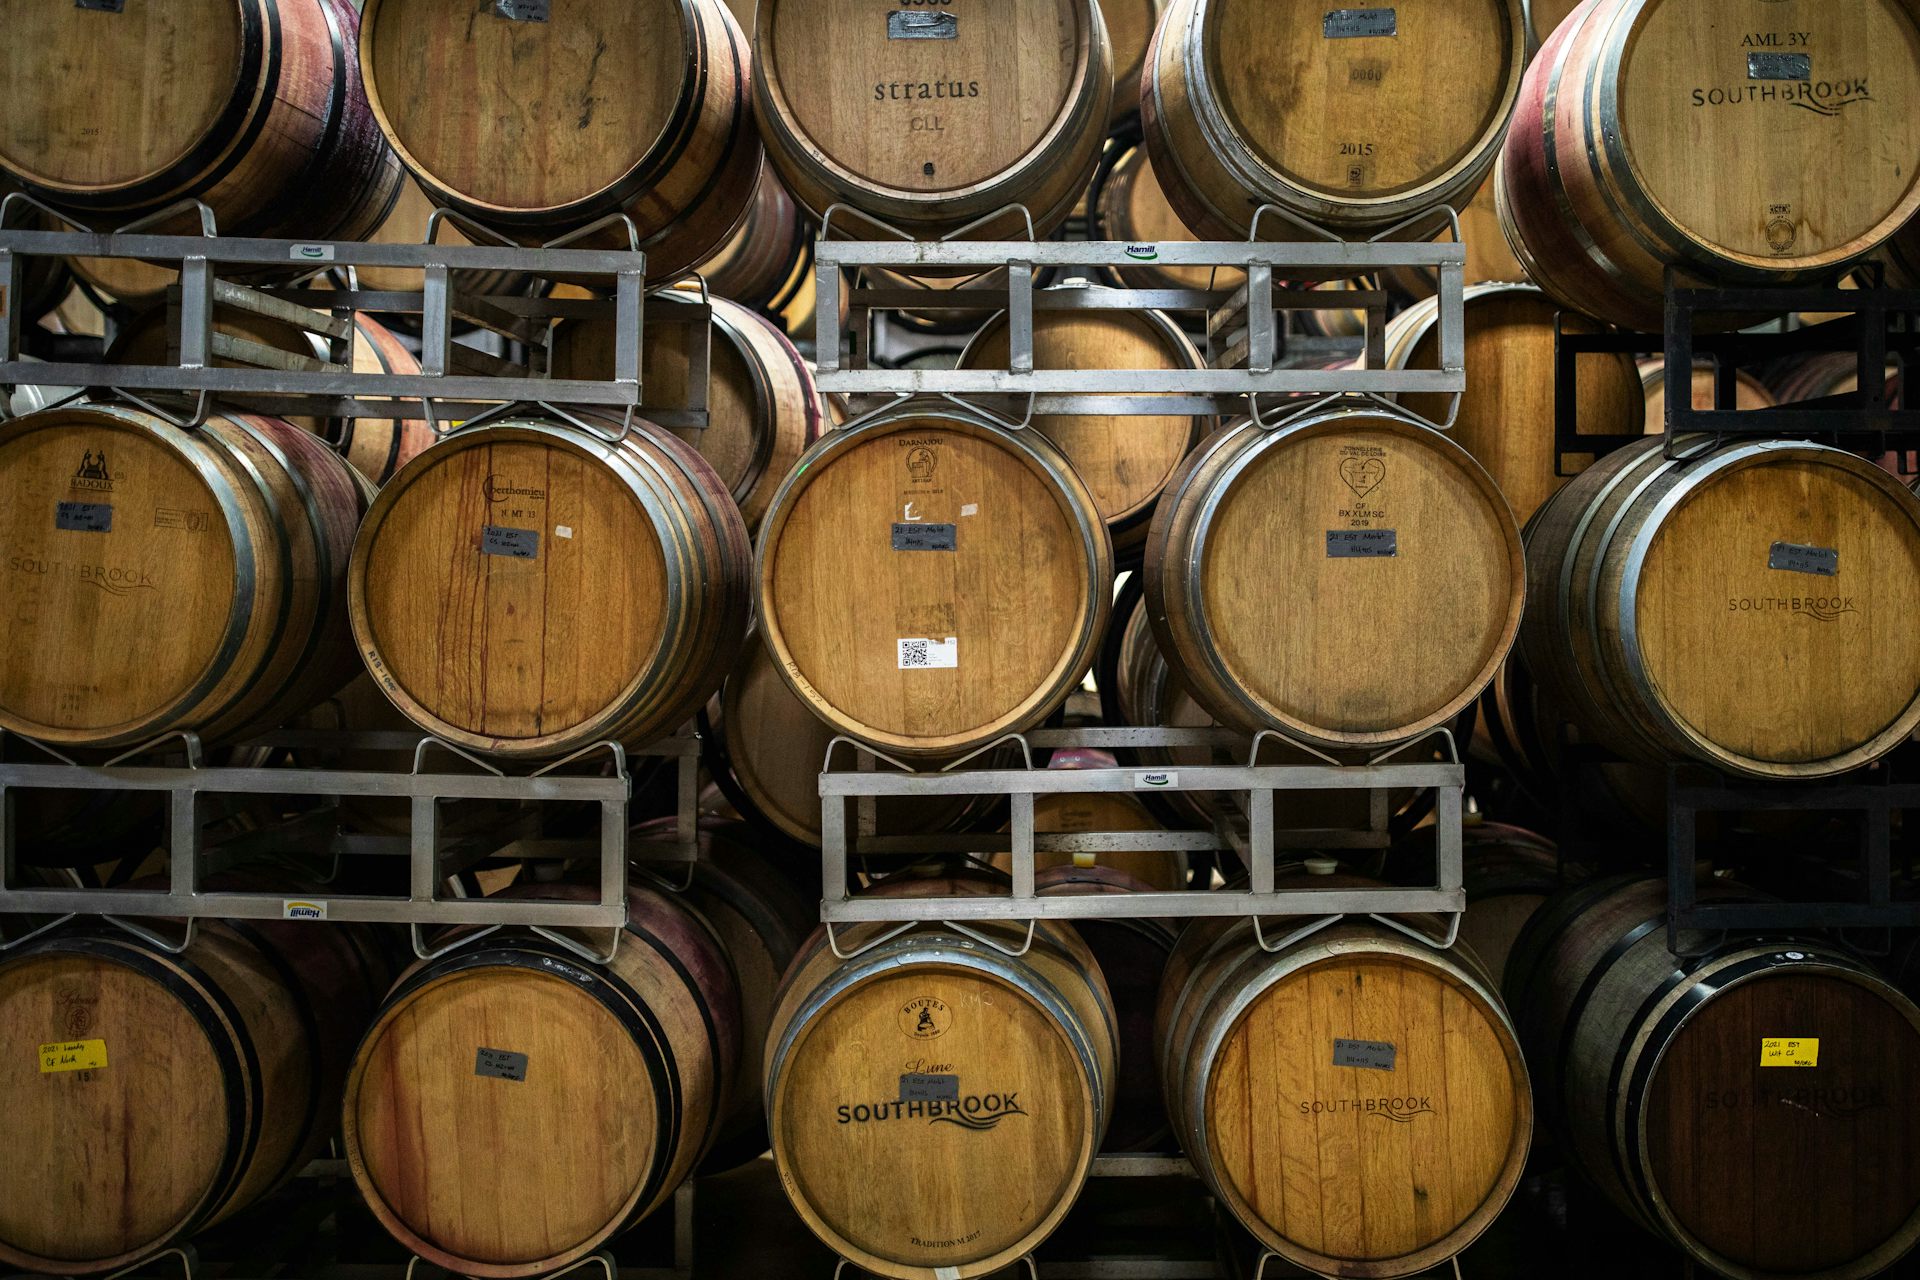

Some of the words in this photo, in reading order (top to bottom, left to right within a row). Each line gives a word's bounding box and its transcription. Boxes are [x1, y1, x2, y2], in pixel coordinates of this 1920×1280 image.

[1741, 33, 1784, 47] AML
[1788, 32, 1812, 47] 3Y
[874, 80, 980, 101] stratus
[1692, 79, 1870, 111] SOUTHBROOK
[1340, 142, 1373, 156] 2015
[1126, 245, 1156, 253] Hamill
[898, 438, 944, 447] DARNAJOU
[10, 556, 154, 590] SOUTHBROOK
[1729, 597, 1855, 616] SOUTHBROOK
[1145, 773, 1167, 781] Hamill
[290, 908, 320, 918] Hamill
[904, 999, 945, 1014] BOUTES
[905, 1058, 955, 1075] Lune
[838, 1093, 1022, 1127] SOUTHBROOK
[1301, 1096, 1432, 1117] SOUTHBROOK
[911, 1237, 956, 1248] TRADITION
